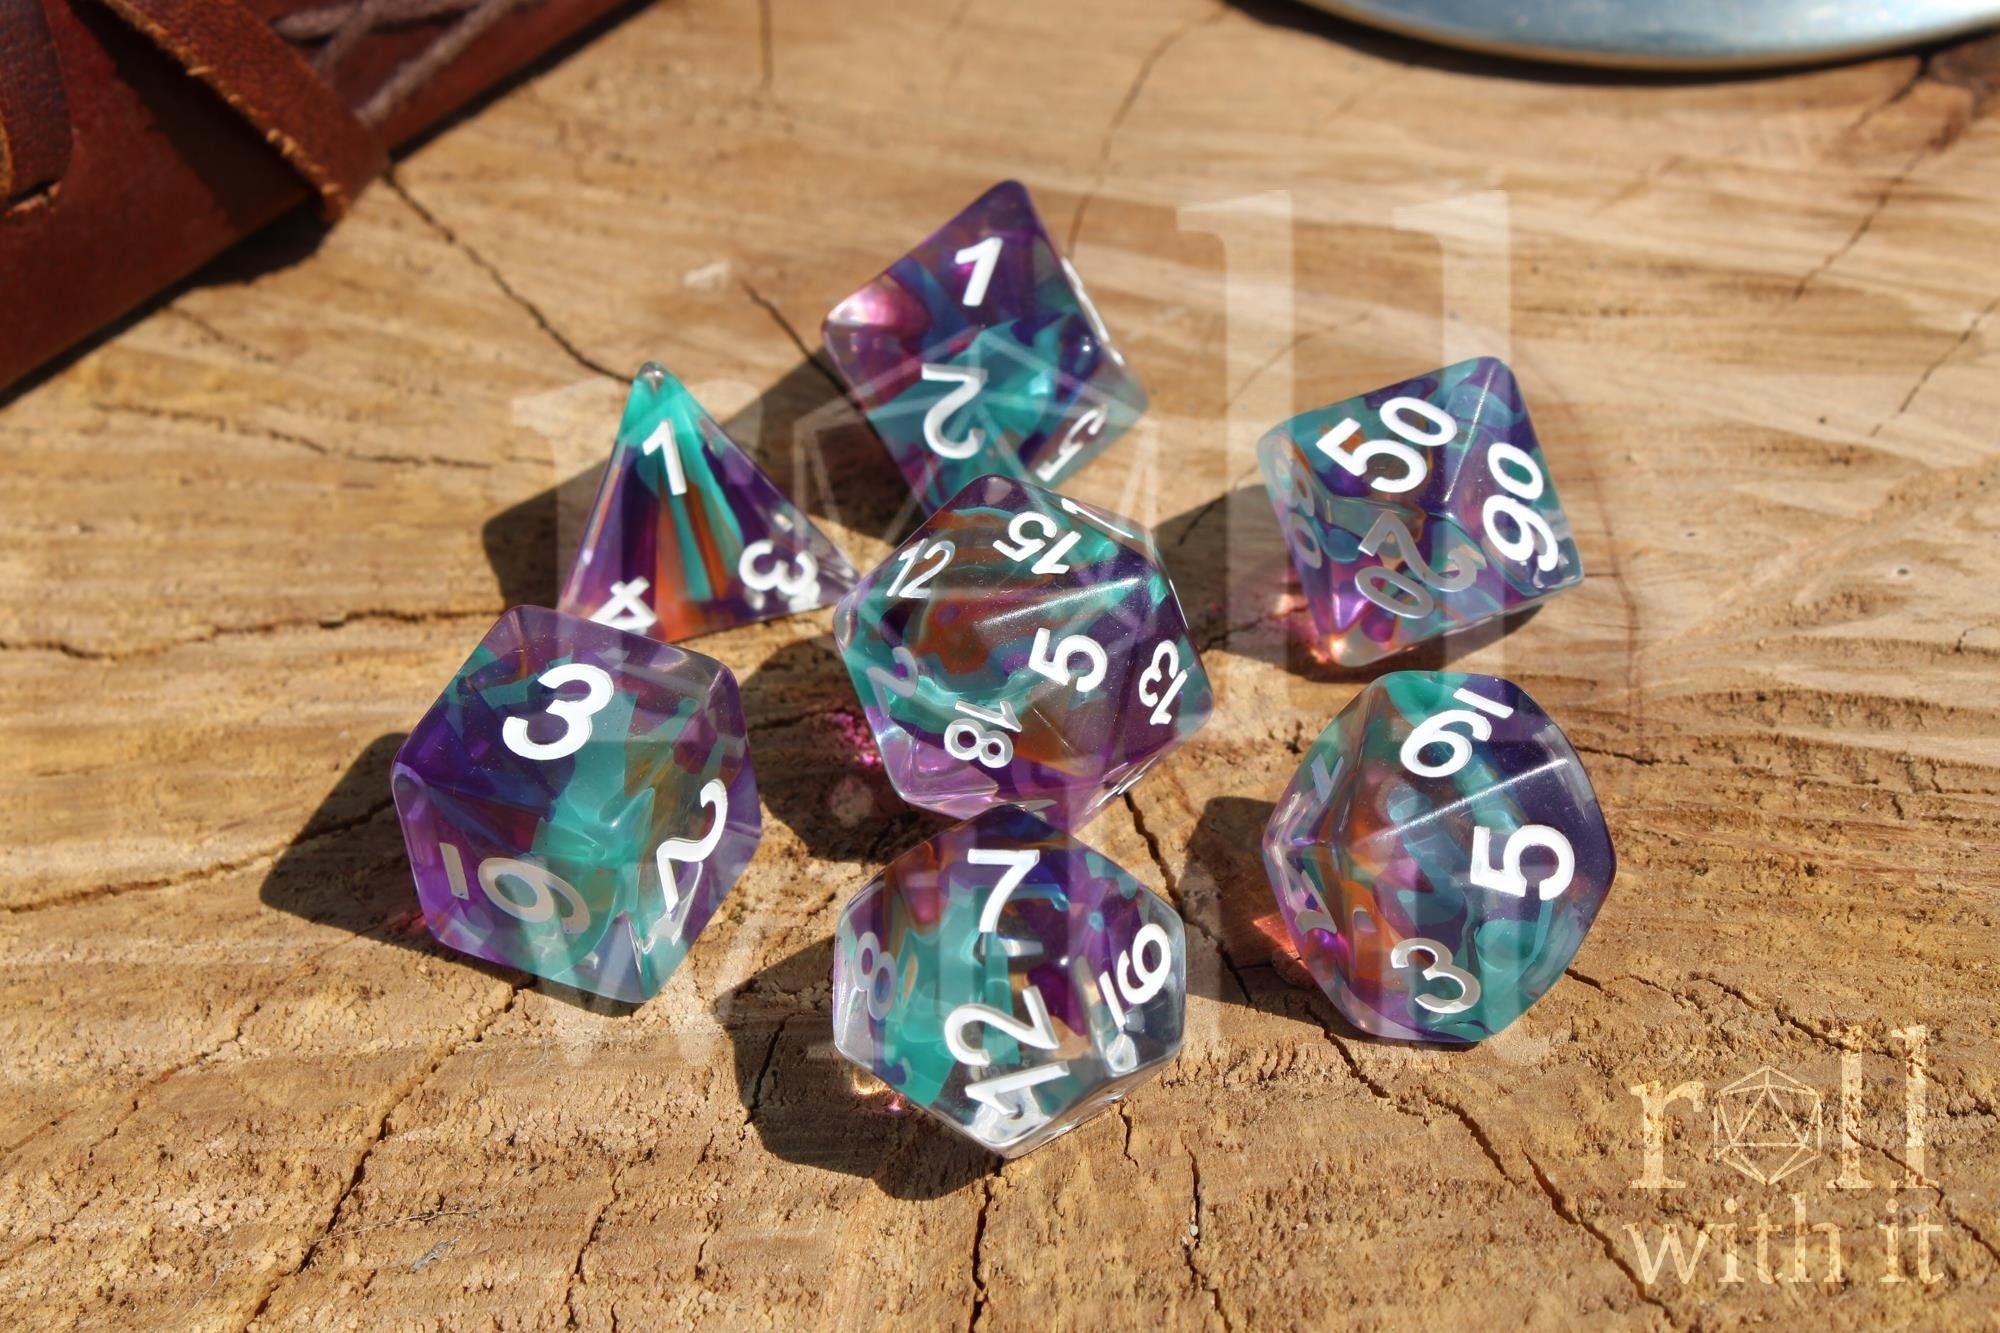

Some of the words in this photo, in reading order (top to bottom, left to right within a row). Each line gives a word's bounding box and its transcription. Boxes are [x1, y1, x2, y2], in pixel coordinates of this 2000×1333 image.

[954, 237, 1003, 307] 1
[921, 364, 988, 459] 2
[1316, 396, 1457, 493] 50
[642, 419, 687, 496] 1
[992, 511, 1081, 575] 15
[1482, 442, 1558, 572] 90
[738, 539, 819, 600] 3
[886, 537, 956, 599] 12
[1028, 627, 1108, 692] 5
[1138, 639, 1188, 726] 13
[502, 663, 614, 760] 3
[943, 700, 1023, 769] 18
[656, 778, 728, 912] 2
[1470, 825, 1575, 901] 5
[967, 848, 1040, 933] 7
[852, 931, 898, 1021] 8
[1390, 938, 1481, 1014] 3
[944, 985, 1070, 1116] 12
